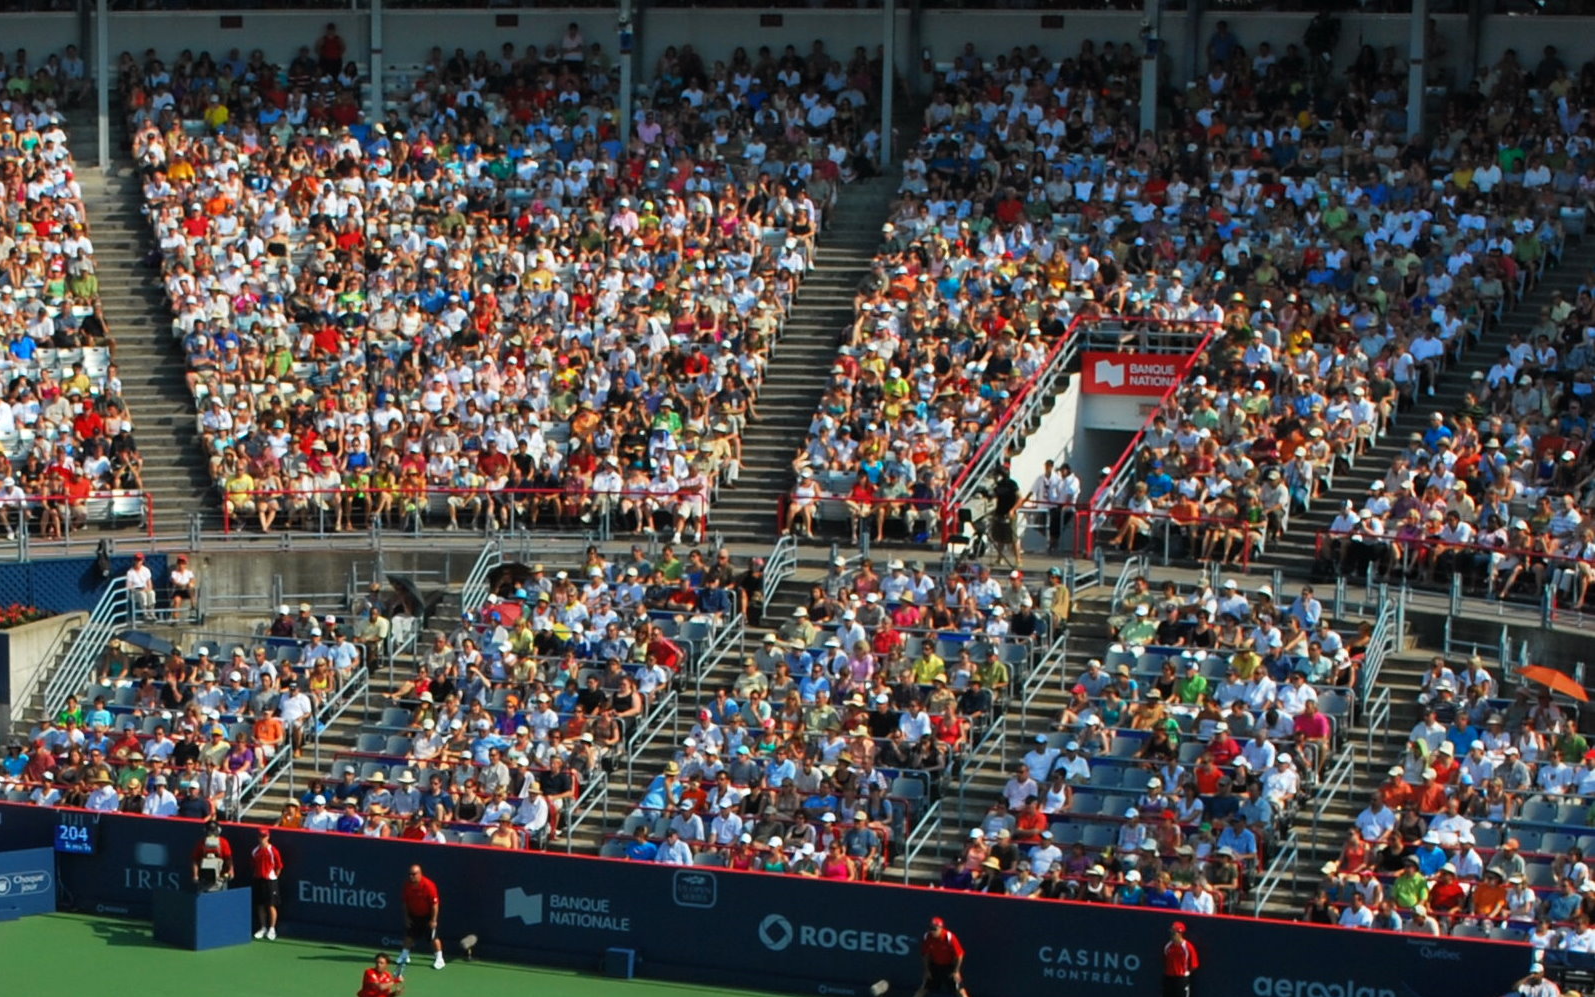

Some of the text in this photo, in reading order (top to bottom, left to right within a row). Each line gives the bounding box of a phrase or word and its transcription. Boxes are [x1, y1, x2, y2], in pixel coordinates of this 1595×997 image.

[1130, 363, 1175, 375] BANQUE
[1130, 376, 1176, 387] NATIONA
[59, 825, 89, 842] 204
[13, 873, 45, 886] Chaque
[124, 867, 180, 891] IRIS
[329, 866, 355, 887] Fly
[298, 880, 387, 910] Emirates
[549, 895, 610, 914] BANQUE
[549, 911, 630, 931] NATIONALE
[800, 925, 910, 956] ROGERS
[1038, 946, 1141, 971] CASINO
[1044, 967, 1134, 986] MONTRÉAL
